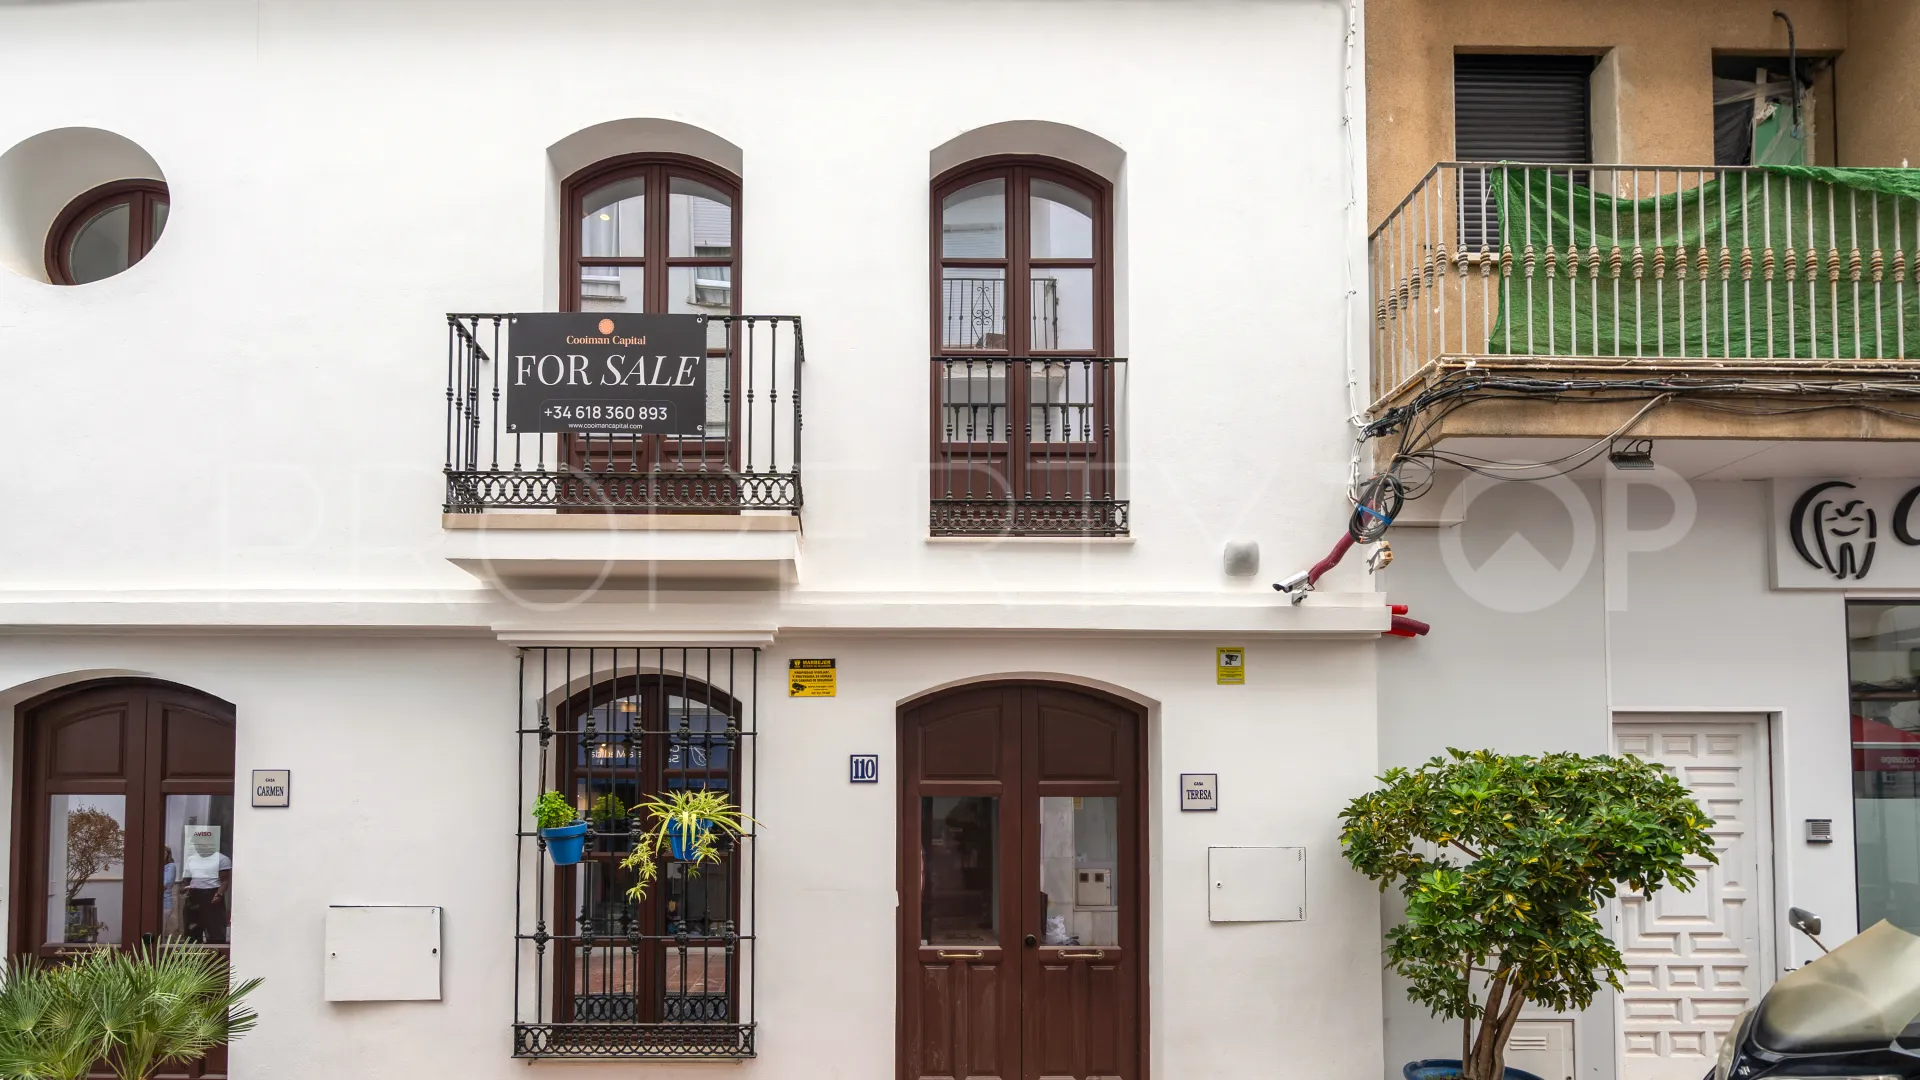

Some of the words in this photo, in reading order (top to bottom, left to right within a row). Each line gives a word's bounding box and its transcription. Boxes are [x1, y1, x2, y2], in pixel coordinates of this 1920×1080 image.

[566, 335, 610, 345] Cooiman
[612, 335, 646, 348] Capital
[514, 354, 593, 386] FOR
[600, 354, 701, 387] SALE
[544, 406, 572, 419] +34
[575, 406, 601, 419] 618
[605, 406, 635, 420] 360
[638, 407, 668, 420] 893
[853, 758, 875, 779] 110
[257, 785, 284, 797] CARMEN
[1186, 789, 1212, 800] TERESA
